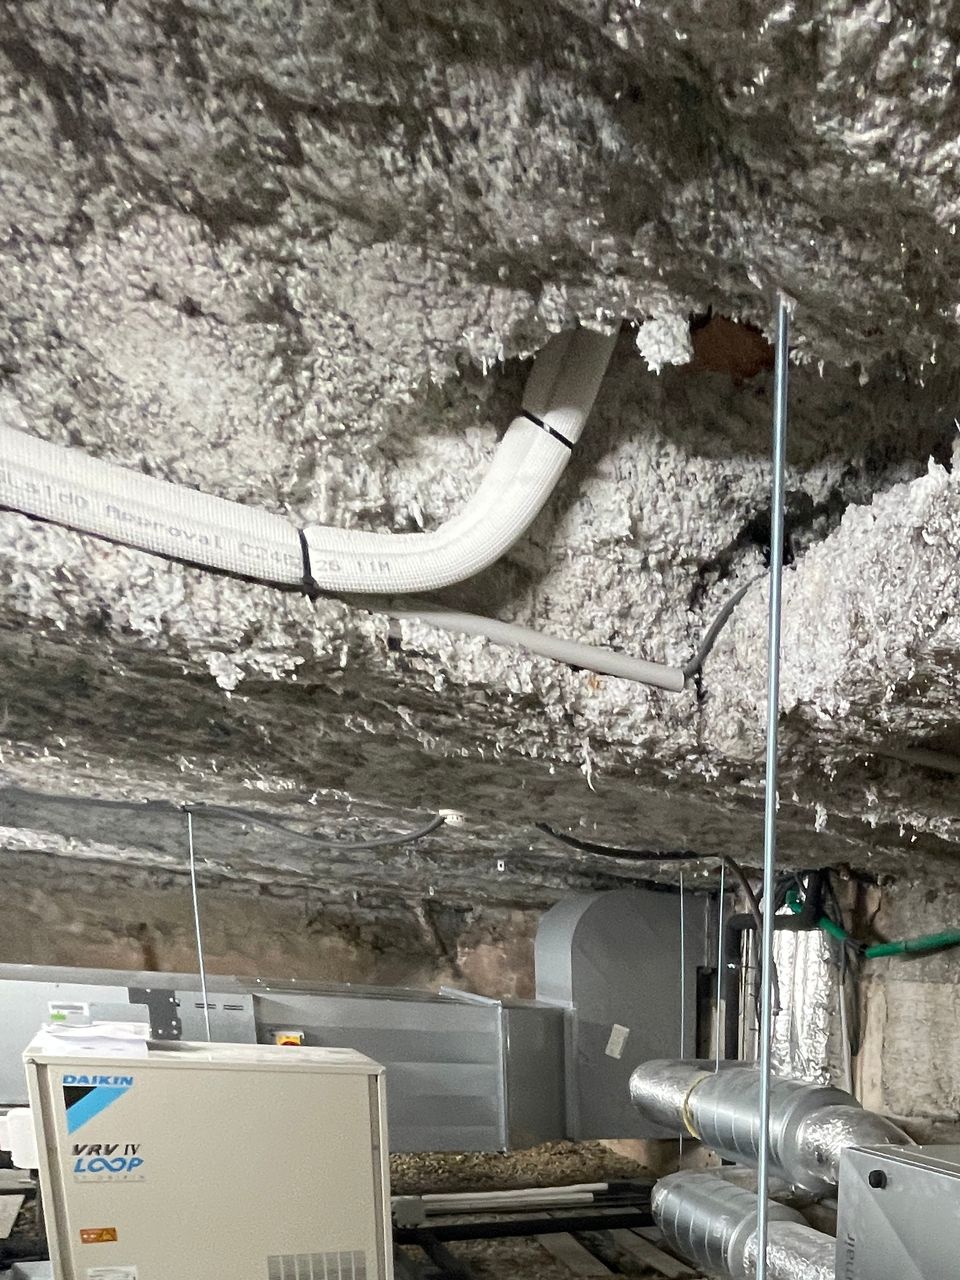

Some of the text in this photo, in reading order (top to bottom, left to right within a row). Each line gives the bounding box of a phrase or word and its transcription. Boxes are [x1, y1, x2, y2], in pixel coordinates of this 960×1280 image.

[63, 1075, 133, 1086] DAIKIN
[72, 1144, 141, 1156] VRV IV
